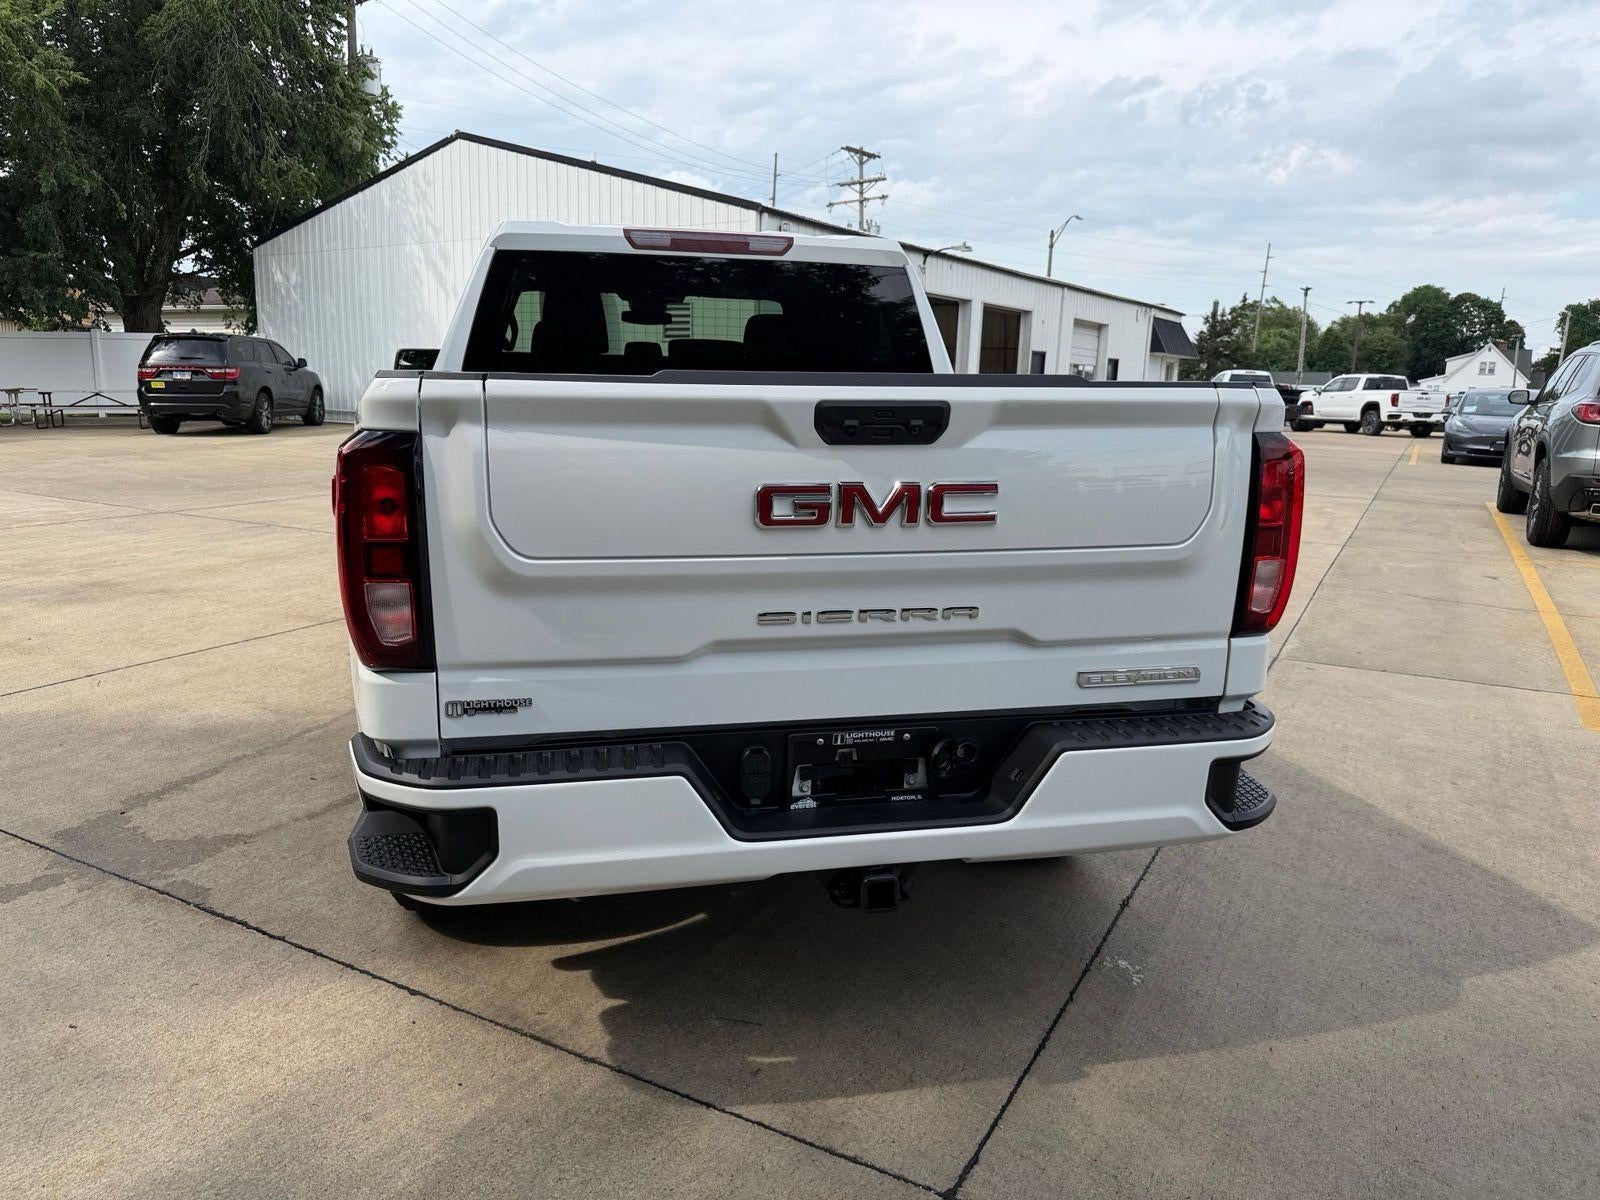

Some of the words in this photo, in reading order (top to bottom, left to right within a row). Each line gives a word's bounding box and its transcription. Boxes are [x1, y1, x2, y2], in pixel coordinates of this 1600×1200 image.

[755, 481, 999, 530] GMC
[757, 606, 980, 626] SIERRA
[1086, 668, 1195, 684] ELEVATION
[463, 698, 533, 709] LIGHTHOUSE
[846, 730, 896, 739] LIGHTHOUSE
